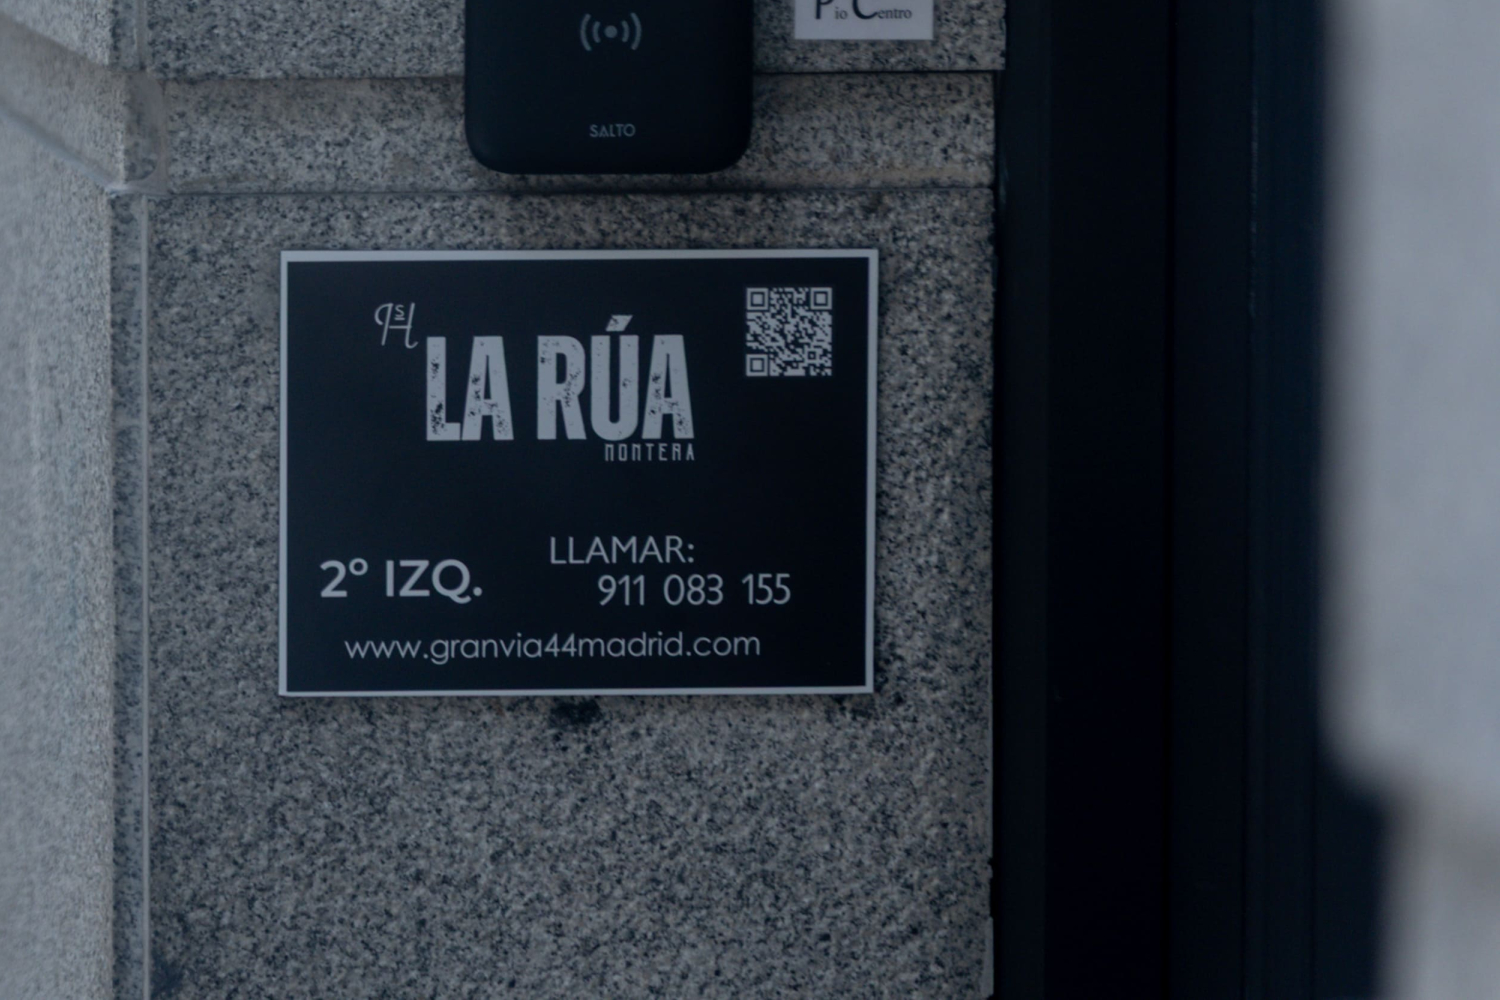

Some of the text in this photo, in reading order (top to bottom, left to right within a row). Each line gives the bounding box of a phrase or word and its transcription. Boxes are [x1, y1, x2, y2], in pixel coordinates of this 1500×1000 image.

[588, 123, 637, 138] SALTO
[426, 314, 695, 441] LA RÚA
[550, 535, 695, 565] LLAMAR:
[319, 557, 483, 605] 2º IZQ.
[597, 572, 792, 607] 911 083 155
[343, 630, 762, 666] www.granvia44madrid.com
